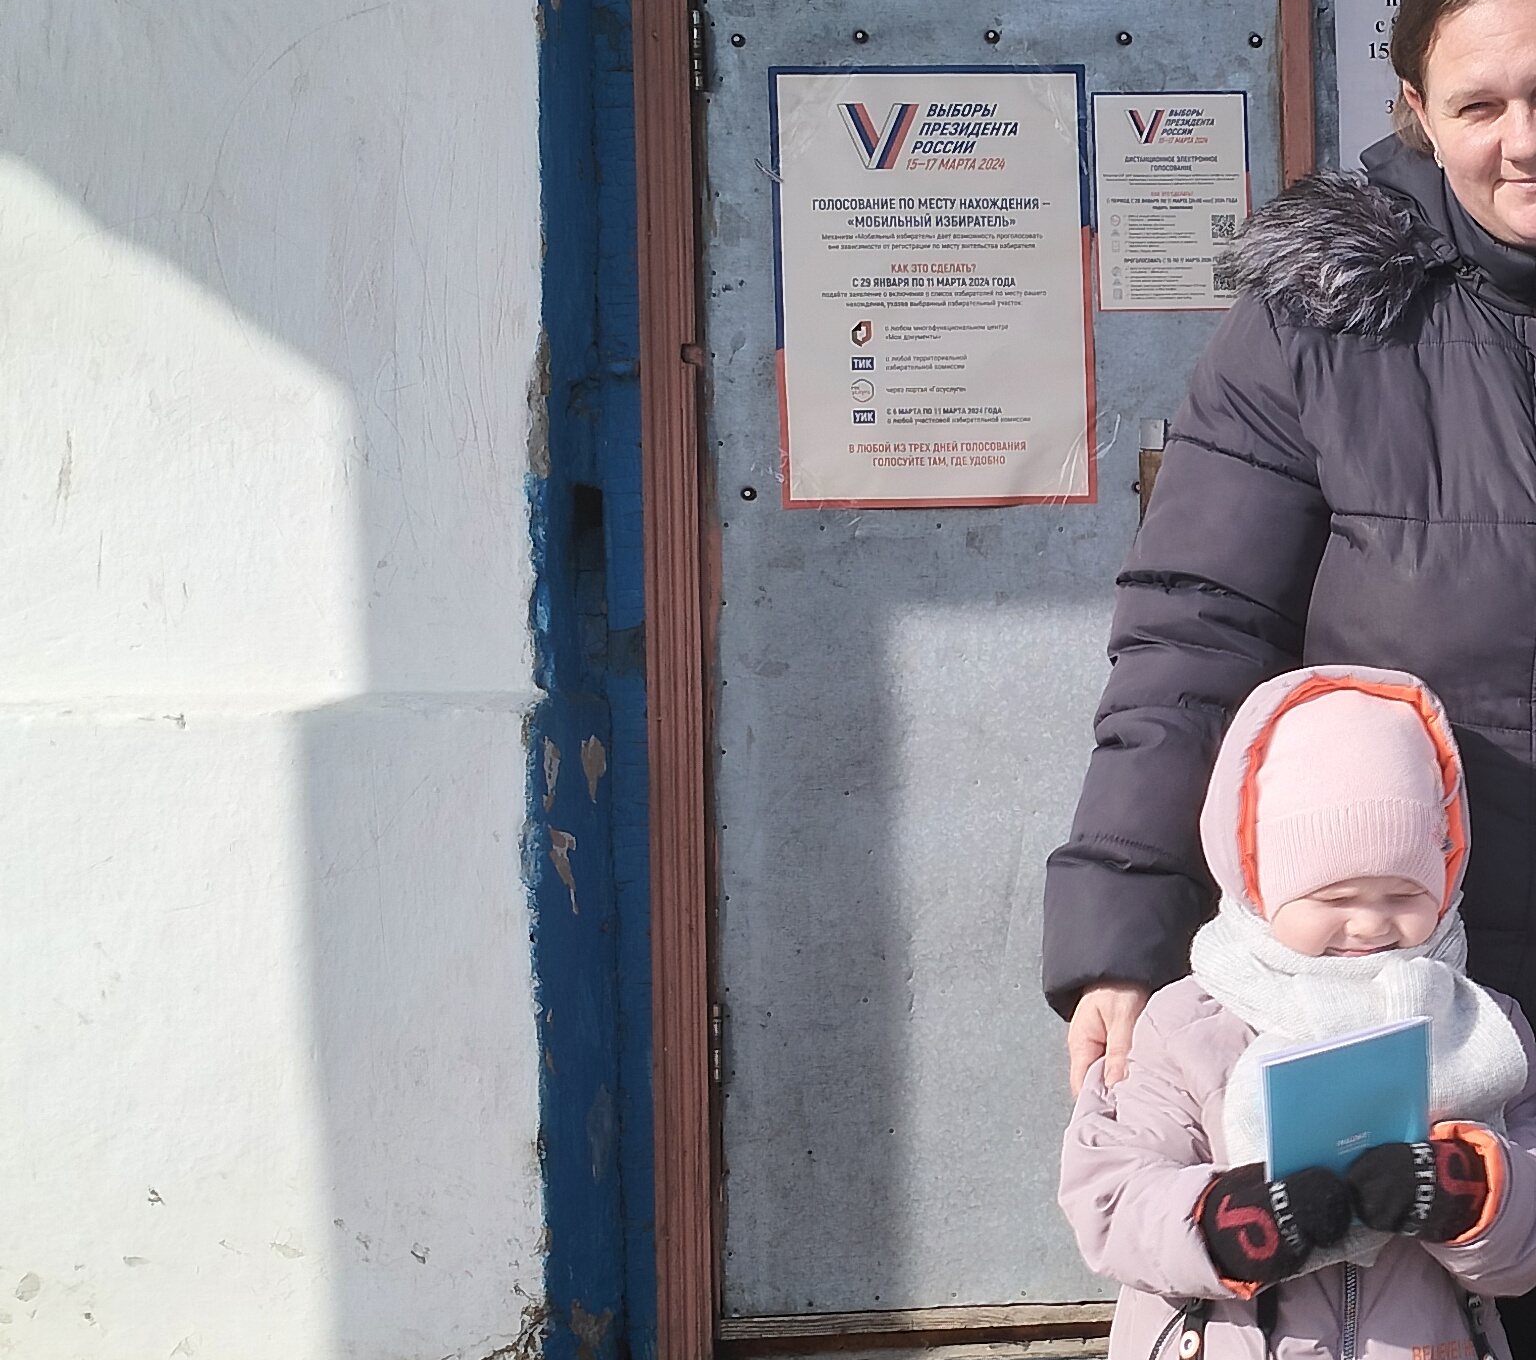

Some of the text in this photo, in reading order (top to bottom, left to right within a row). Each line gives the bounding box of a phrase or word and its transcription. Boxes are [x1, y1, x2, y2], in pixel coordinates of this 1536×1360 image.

[926, 103, 998, 117] ВЫБОРЫ
[1168, 109, 1204, 117] ВЫБОРЫ
[1165, 118, 1215, 127] ПРЕЗИДЕНТА
[918, 122, 1019, 138] ПРЕЗИДЕНТА
[1161, 128, 1193, 136] РОССИИ
[911, 141, 976, 154] РОССИИ
[938, 158, 976, 170] МАРТА
[978, 158, 1006, 171] 2024
[812, 198, 1040, 211] ГОЛОСОВАНИЕ ПО МЕСТУ НАХОЖДЕНИЯ
[848, 212, 1016, 228] «МОБИЛЬНЫЙ ИЗБИРАТЕЛЬ»
[891, 264, 976, 274] КАК ЭТО СДЕЛАТЬ?
[852, 277, 1016, 288] С 29 ЯНВАРЯ ПО 11 МАРТА 2024 ГОДА
[853, 358, 873, 369] ТИК
[855, 412, 874, 422] УИК
[849, 441, 1026, 453] В ЛЮБОЙ ИЗ ТРЕХ ДНЕЙ ГОЛОСОВАНИЯ
[873, 456, 1006, 468] ГОЛОСУЙТЕ ТАМ, ГДЕ УДОБНО
